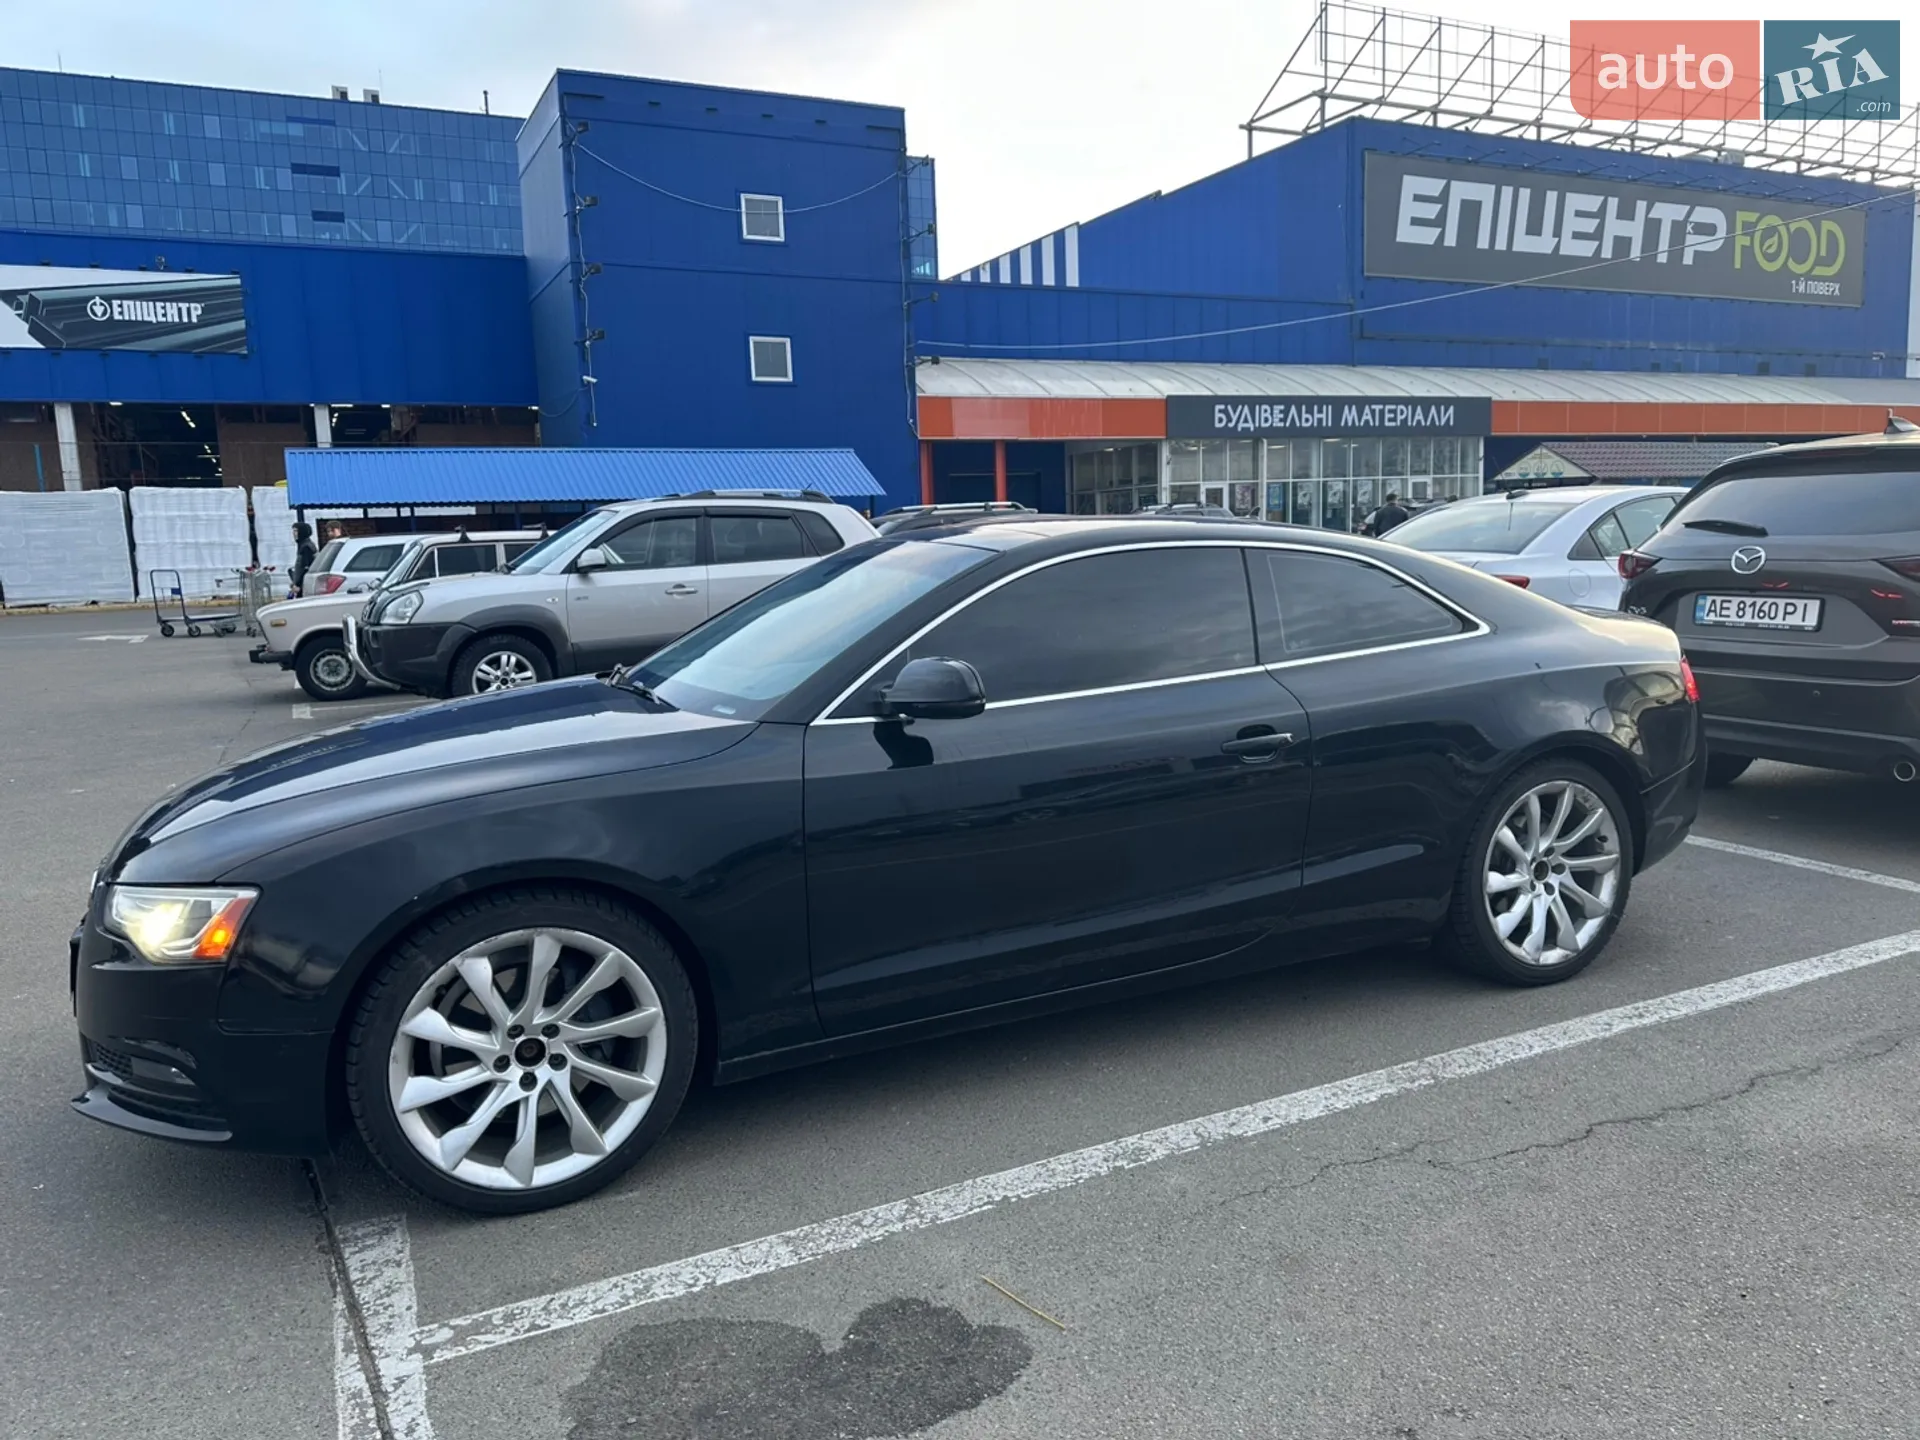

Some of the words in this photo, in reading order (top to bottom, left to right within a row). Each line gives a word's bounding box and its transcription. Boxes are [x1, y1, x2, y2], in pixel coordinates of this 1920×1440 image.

[1396, 174, 1727, 266] ЕПІЦЕНТР
[1734, 210, 1846, 276] FOOD
[1791, 277, 1805, 294] 1-Й
[1807, 280, 1841, 296] ПОВЕРХ
[112, 300, 202, 323] ЕПІЦЕНТР
[1214, 404, 1332, 431] БУДІВЕЛЬНІ
[1340, 404, 1454, 428] МАТЕРІАЛИ
[1706, 599, 1732, 618] AE
[1736, 600, 1779, 620] 8160
